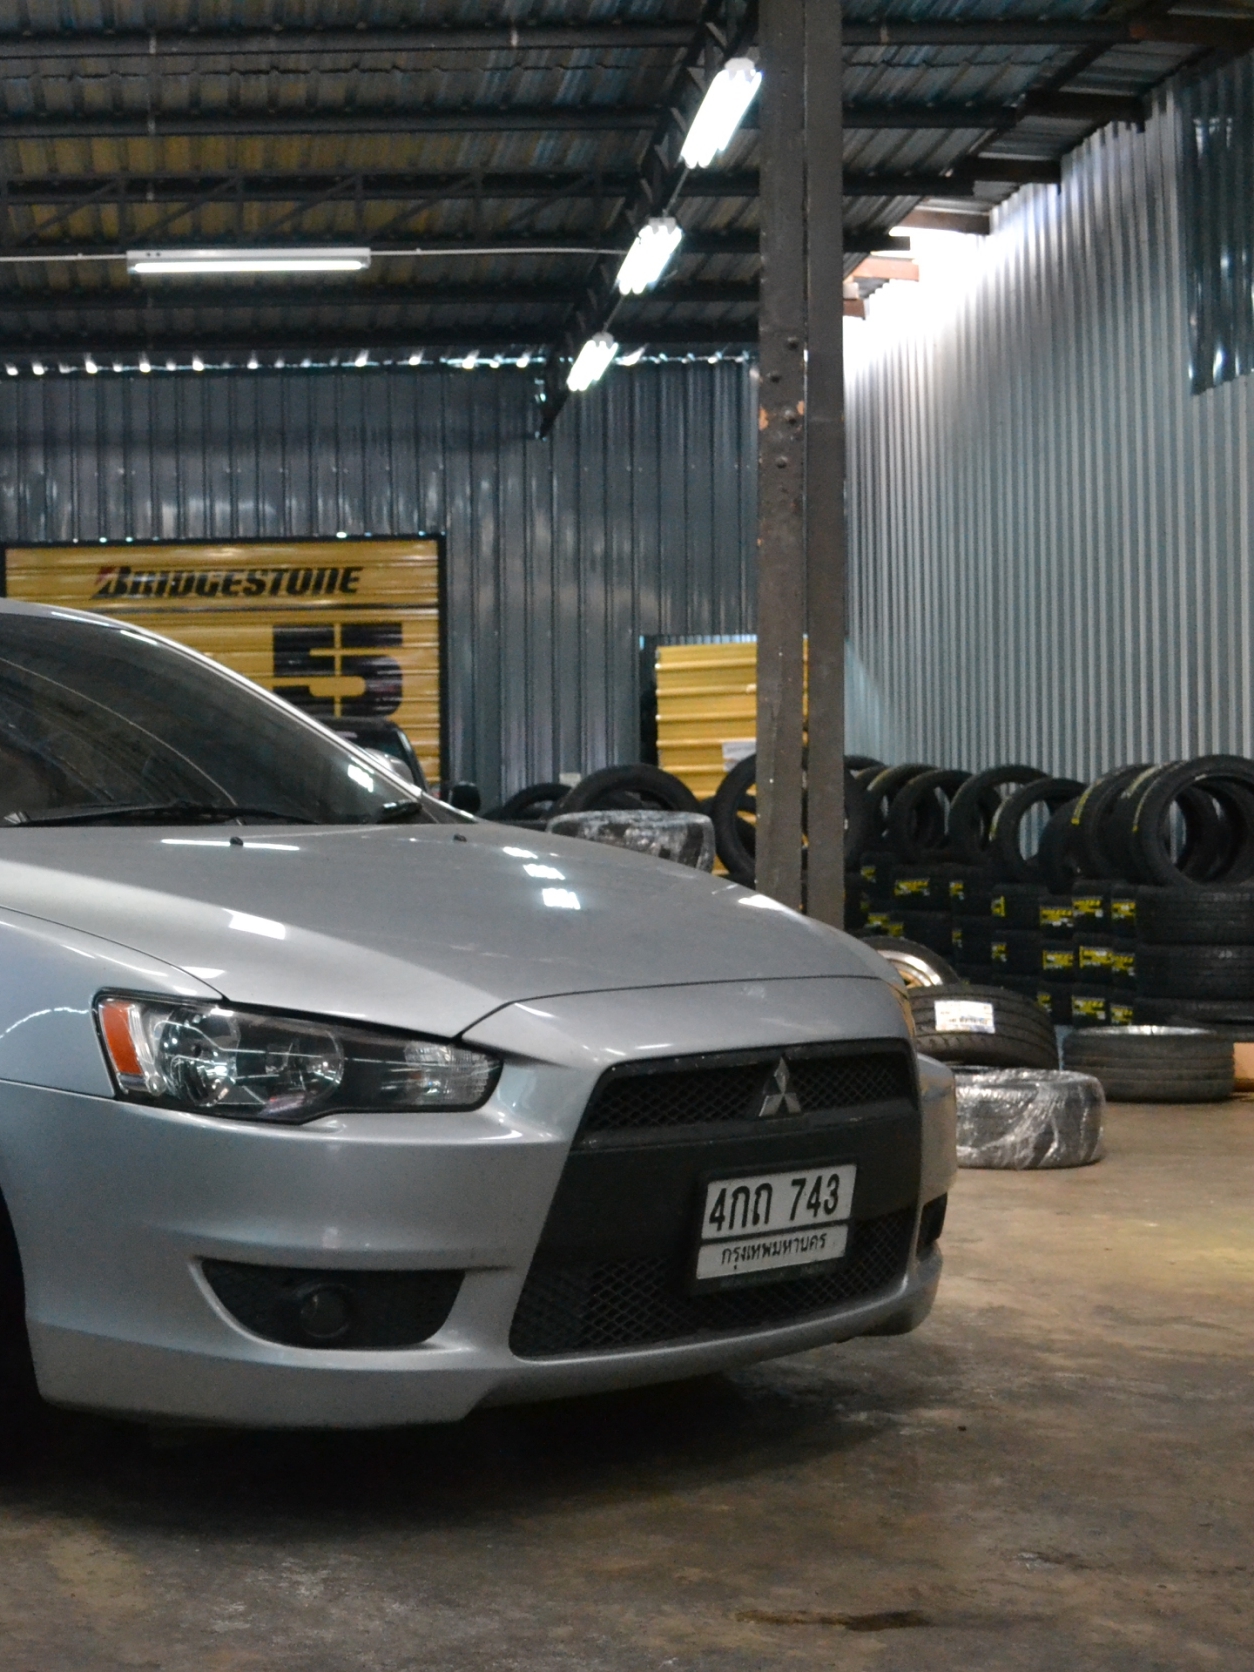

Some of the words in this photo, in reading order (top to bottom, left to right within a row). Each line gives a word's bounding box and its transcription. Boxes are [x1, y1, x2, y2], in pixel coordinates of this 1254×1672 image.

[92, 566, 364, 598] BRIDGESTONE
[789, 1173, 840, 1222] 743
[721, 1232, 827, 1270] กรุงเทพมหานคร
